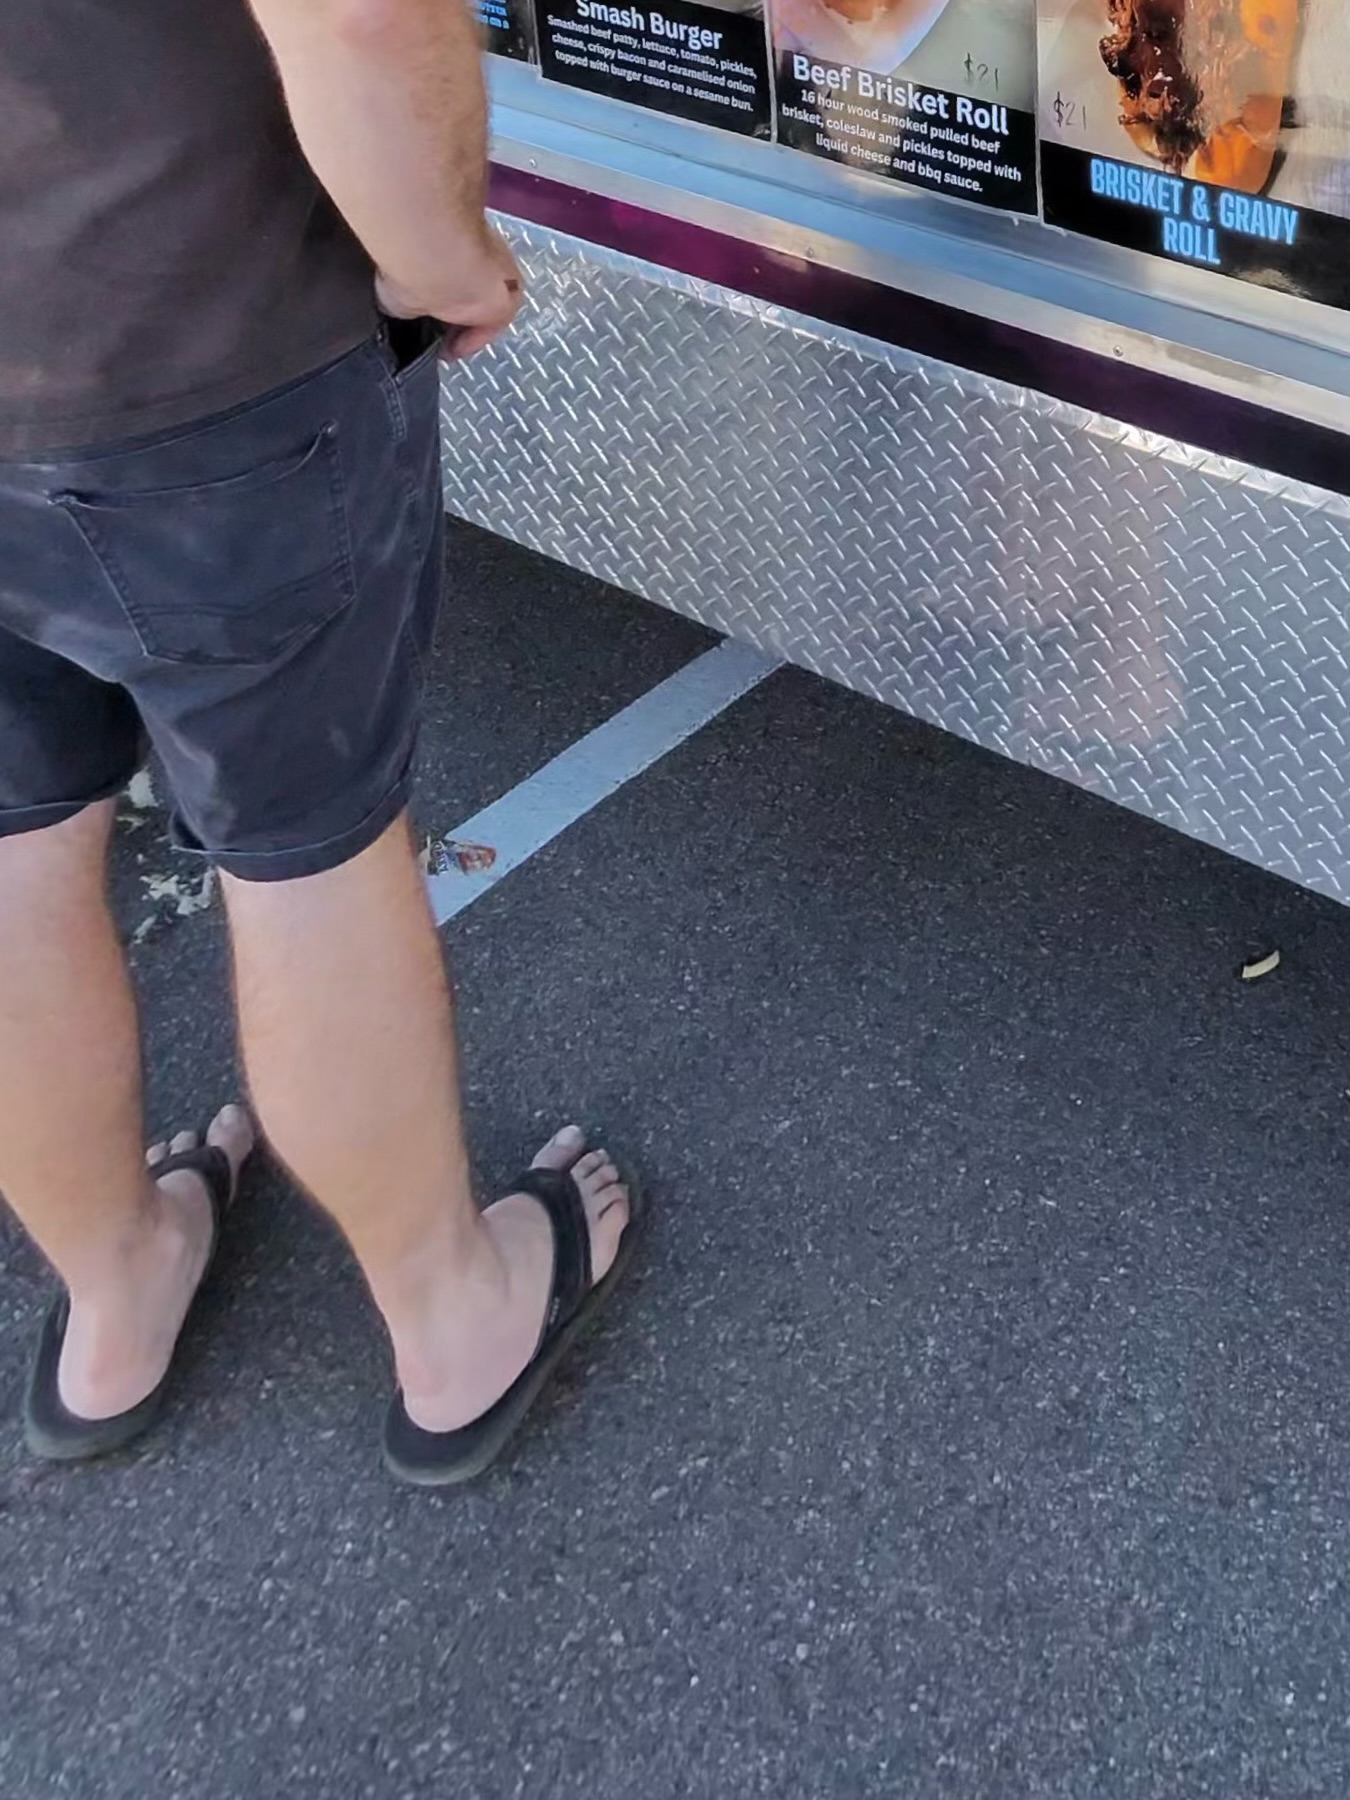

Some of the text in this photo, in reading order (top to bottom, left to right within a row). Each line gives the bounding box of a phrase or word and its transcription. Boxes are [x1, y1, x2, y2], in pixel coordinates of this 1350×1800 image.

[547, 14, 757, 79] Smashed beef patty, lettuce, tomato, pickles,
[649, 12, 723, 50] Burger
[552, 33, 756, 94] cheese, crispy bacon and caramelised onion
[555, 50, 754, 112] topped with burger sauce on a sesame bun.
[793, 54, 1009, 136] Beef Brisket Roll
[801, 89, 1001, 154] 16 hour wood smoked pulled beef
[1053, 91, 1087, 130] $21
[782, 103, 1021, 182] brisket, coleslaw and pickles topped with
[816, 133, 983, 192] liquid cheese and bbq sauce.
[1090, 158, 1299, 245] BRISKET & GRAVY
[1163, 217, 1221, 265] ROLL
